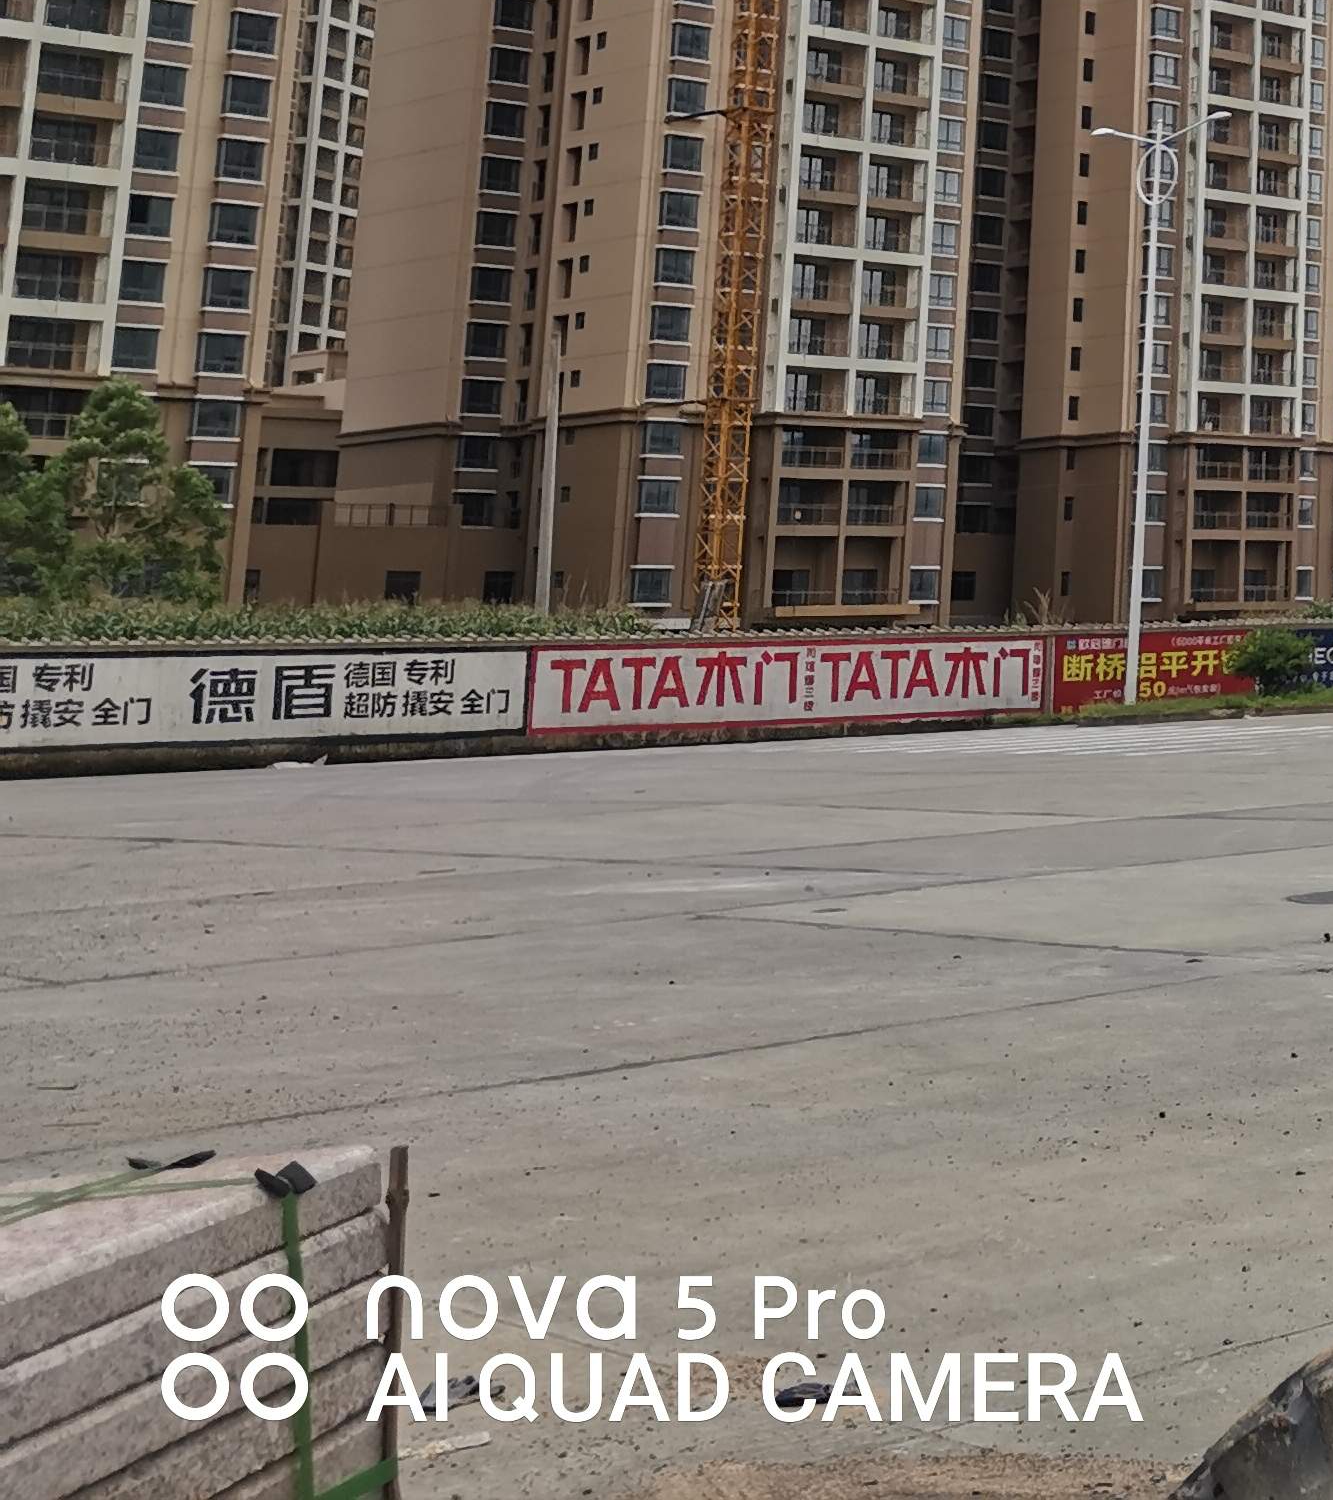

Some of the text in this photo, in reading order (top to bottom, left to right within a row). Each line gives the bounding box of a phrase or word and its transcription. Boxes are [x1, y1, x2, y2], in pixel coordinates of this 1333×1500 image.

[189, 663, 336, 724] 德盾
[550, 651, 800, 713] TATA木门
[820, 647, 1032, 703] TATA木门
